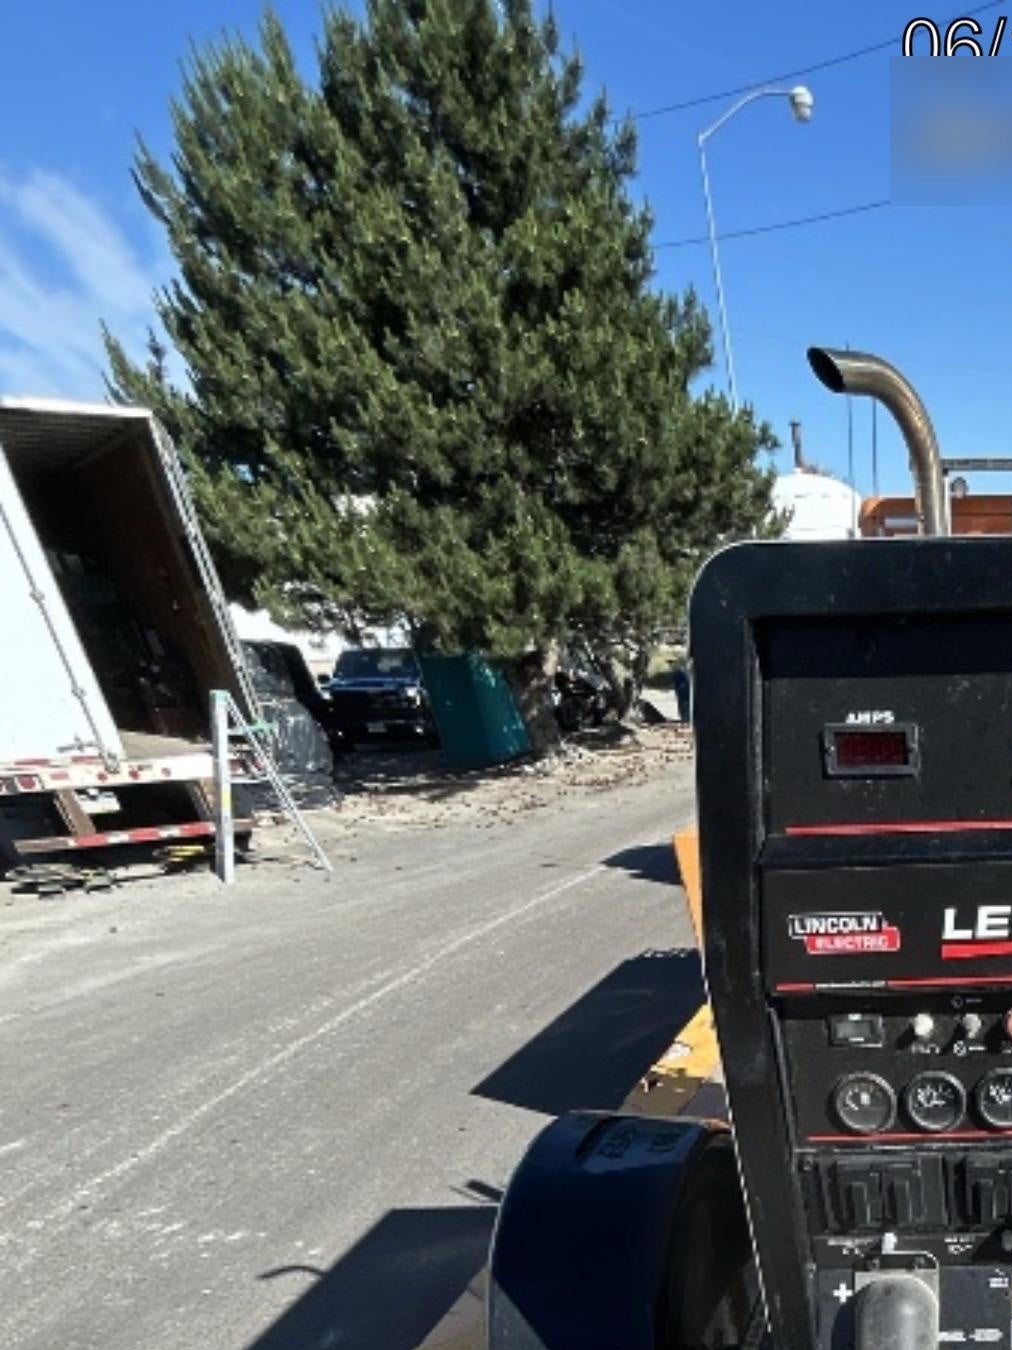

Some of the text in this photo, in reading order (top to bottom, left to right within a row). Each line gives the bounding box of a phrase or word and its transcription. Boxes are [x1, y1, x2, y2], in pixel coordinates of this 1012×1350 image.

[845, 710, 895, 724] AMPS
[794, 915, 877, 934] LINCOLN
[815, 935, 888, 950] ELECTRIC
